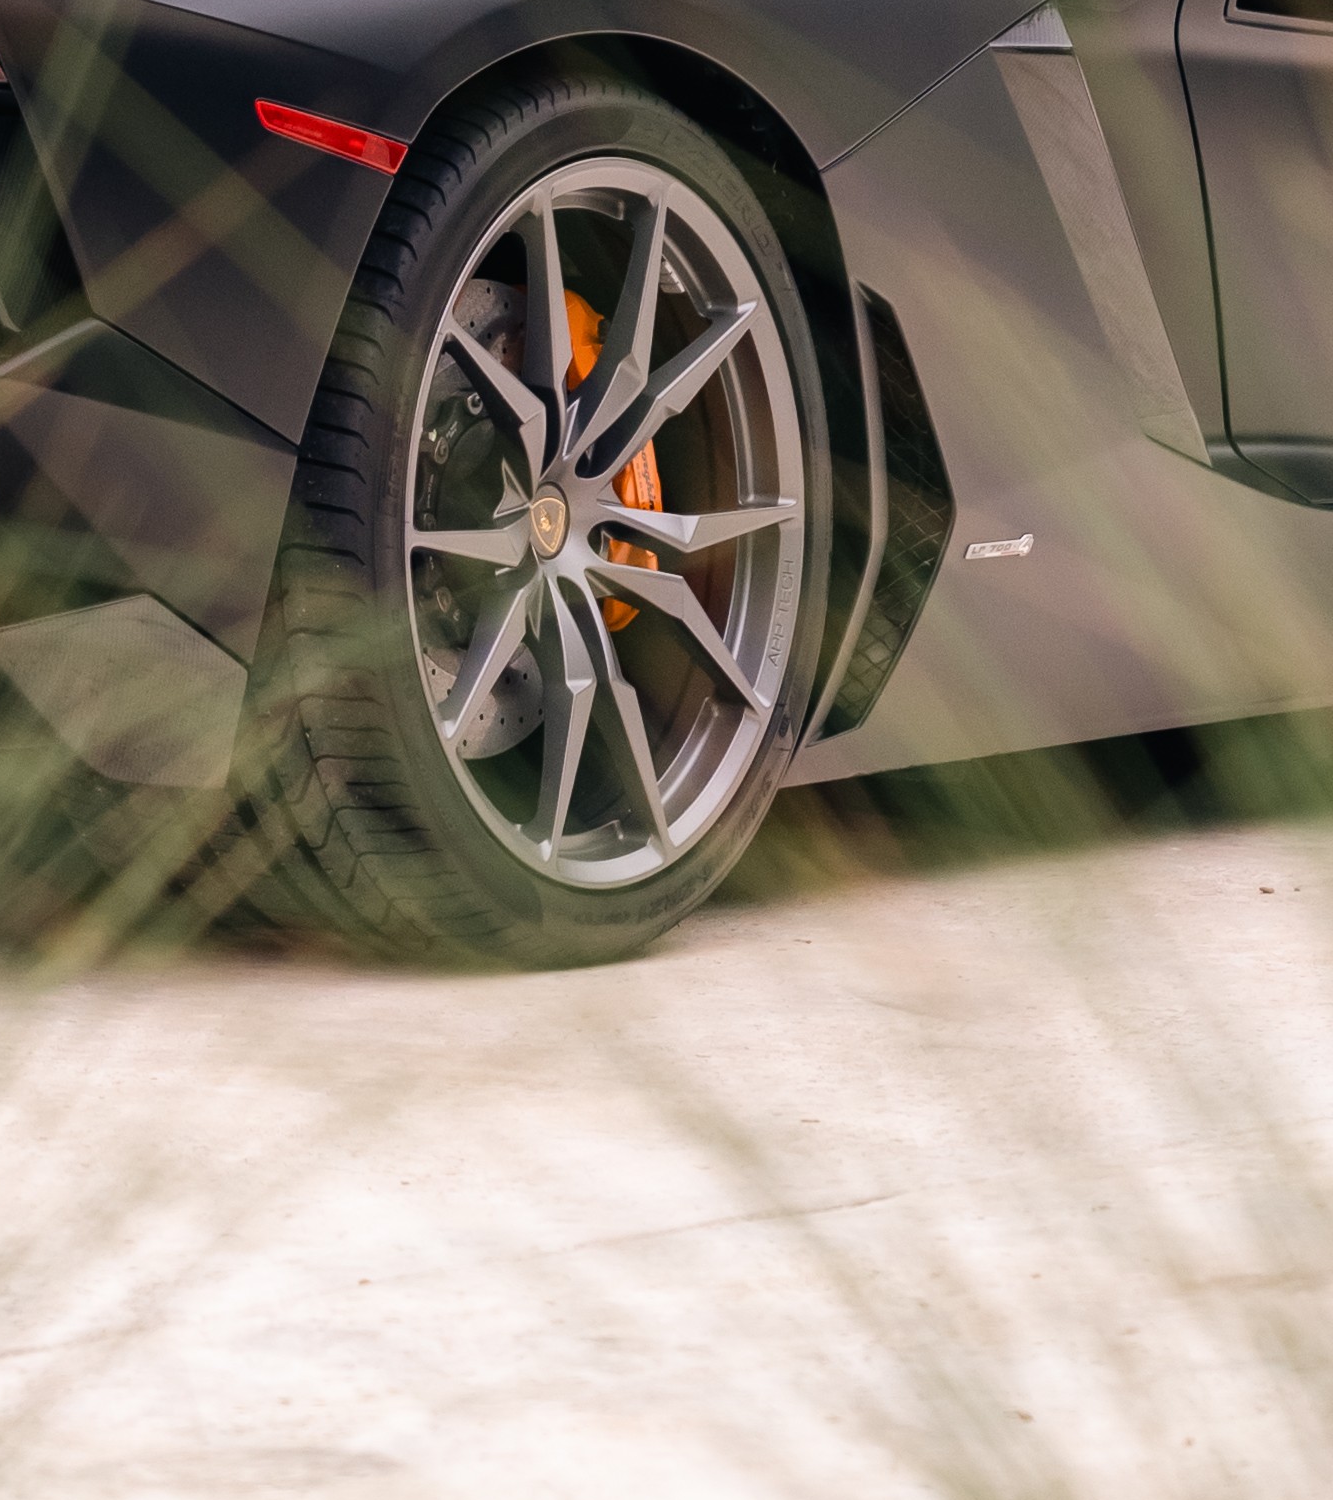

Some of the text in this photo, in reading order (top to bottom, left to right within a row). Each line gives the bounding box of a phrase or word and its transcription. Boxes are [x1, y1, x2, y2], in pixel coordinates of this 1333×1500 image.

[971, 546, 985, 555] LP
[767, 560, 795, 668] APP TECH
